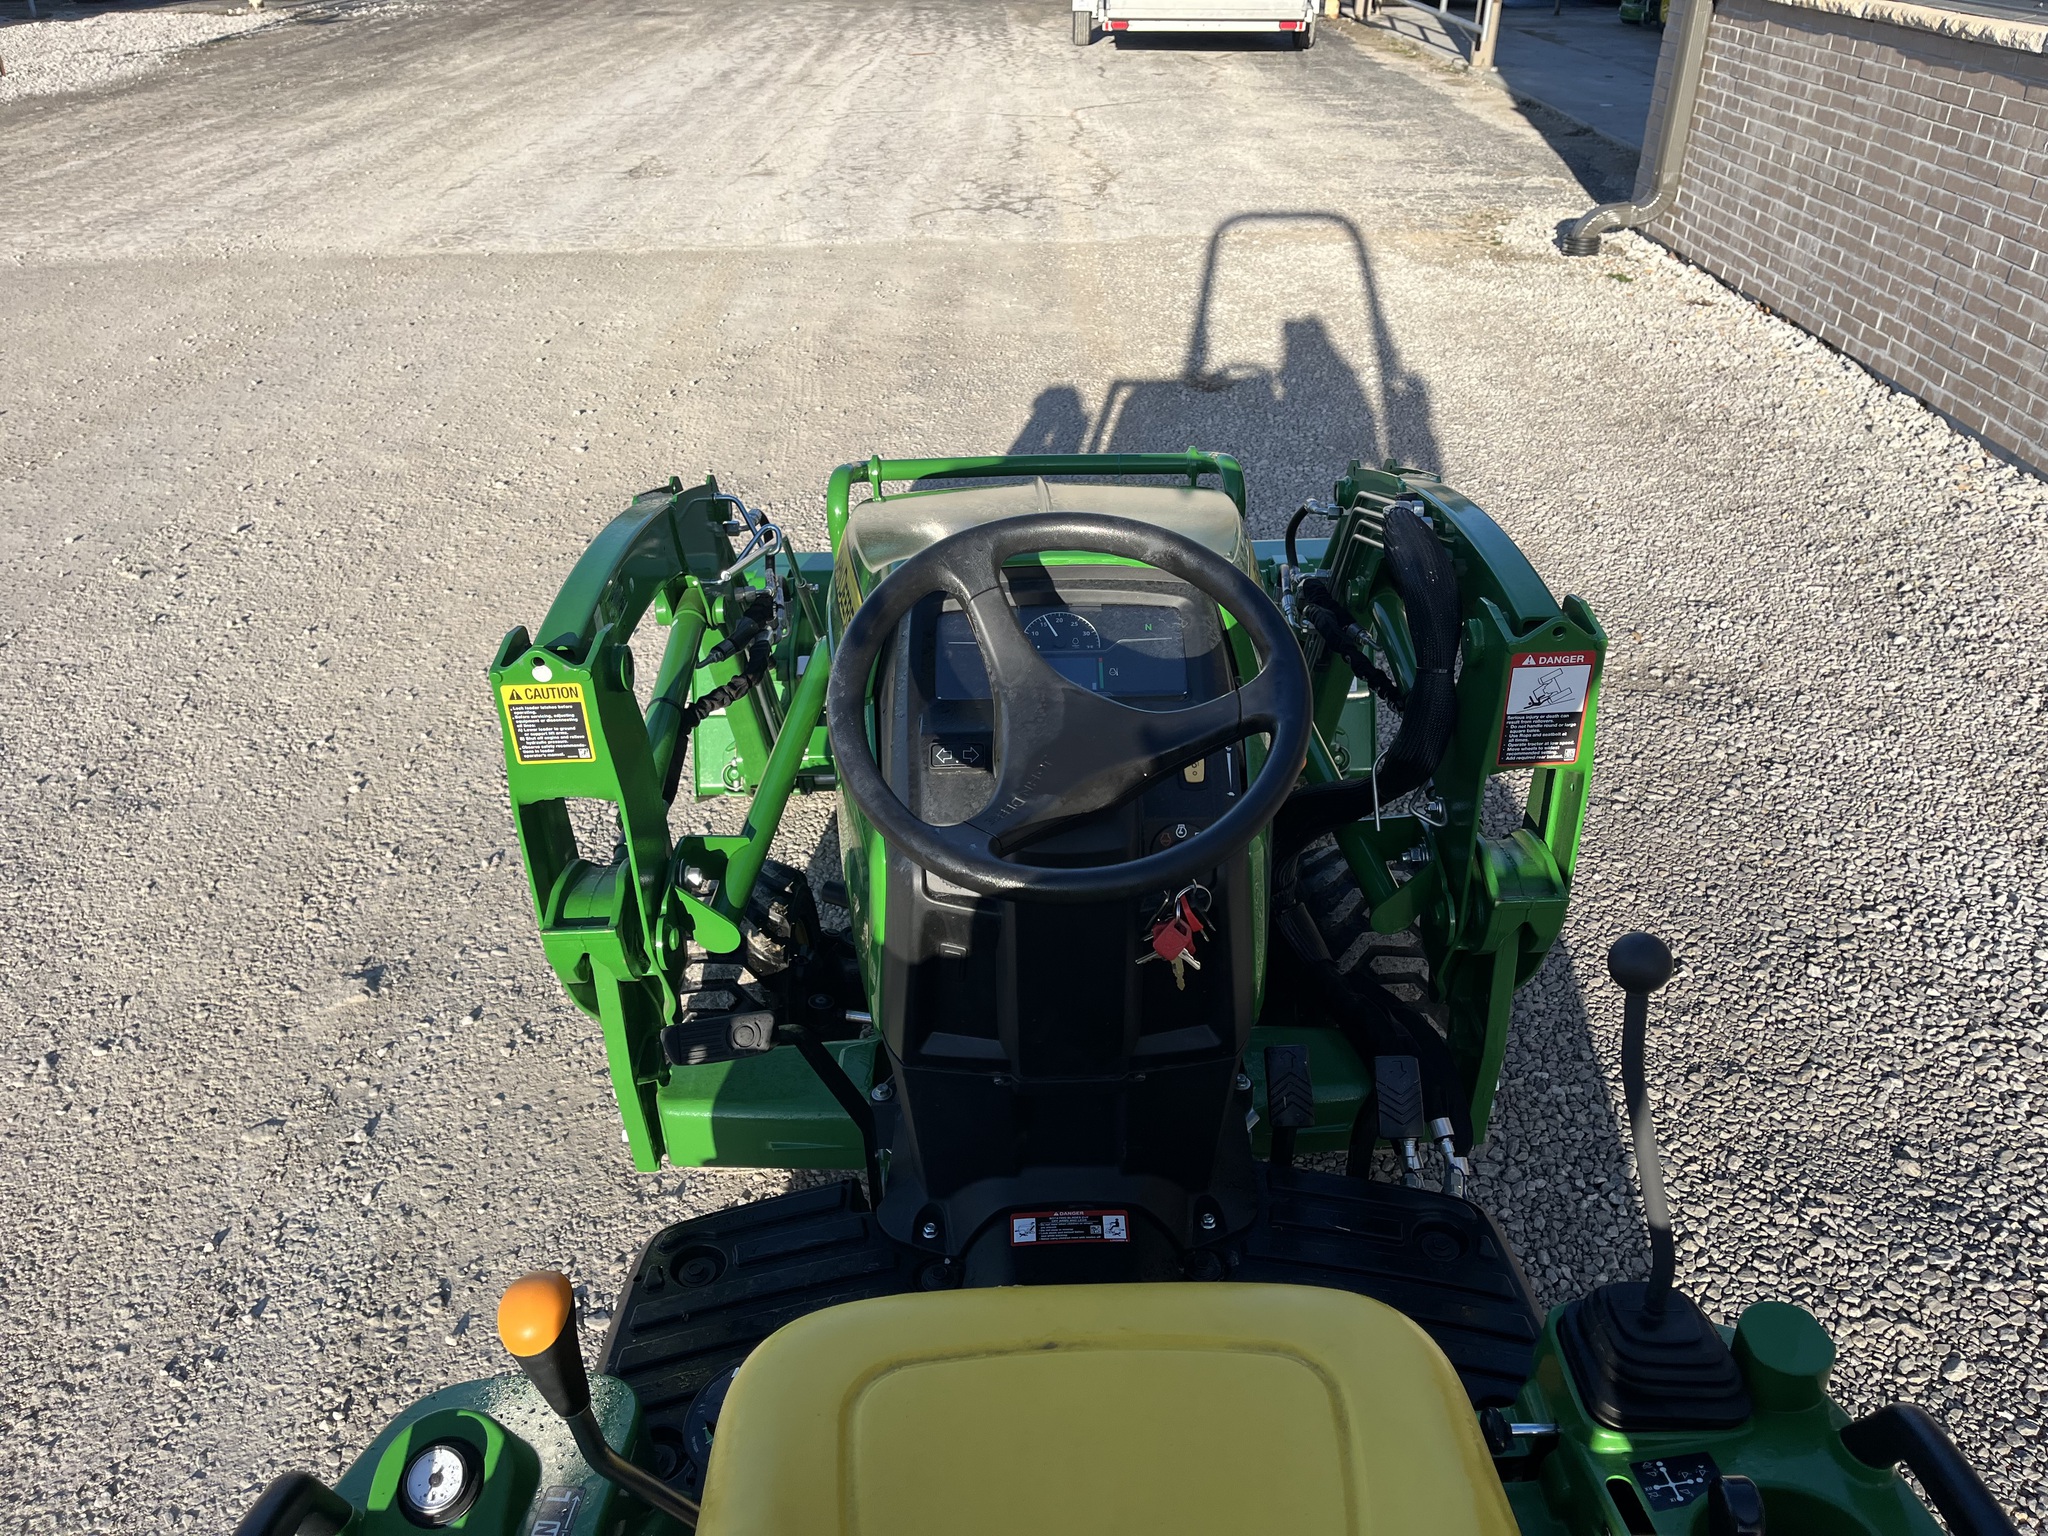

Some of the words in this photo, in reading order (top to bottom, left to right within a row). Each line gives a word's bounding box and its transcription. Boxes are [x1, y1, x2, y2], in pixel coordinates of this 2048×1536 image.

[1539, 655, 1584, 664] DANGER
[524, 687, 578, 699] CAUTION
[546, 1490, 572, 1502] L
[534, 1522, 558, 1536] N
